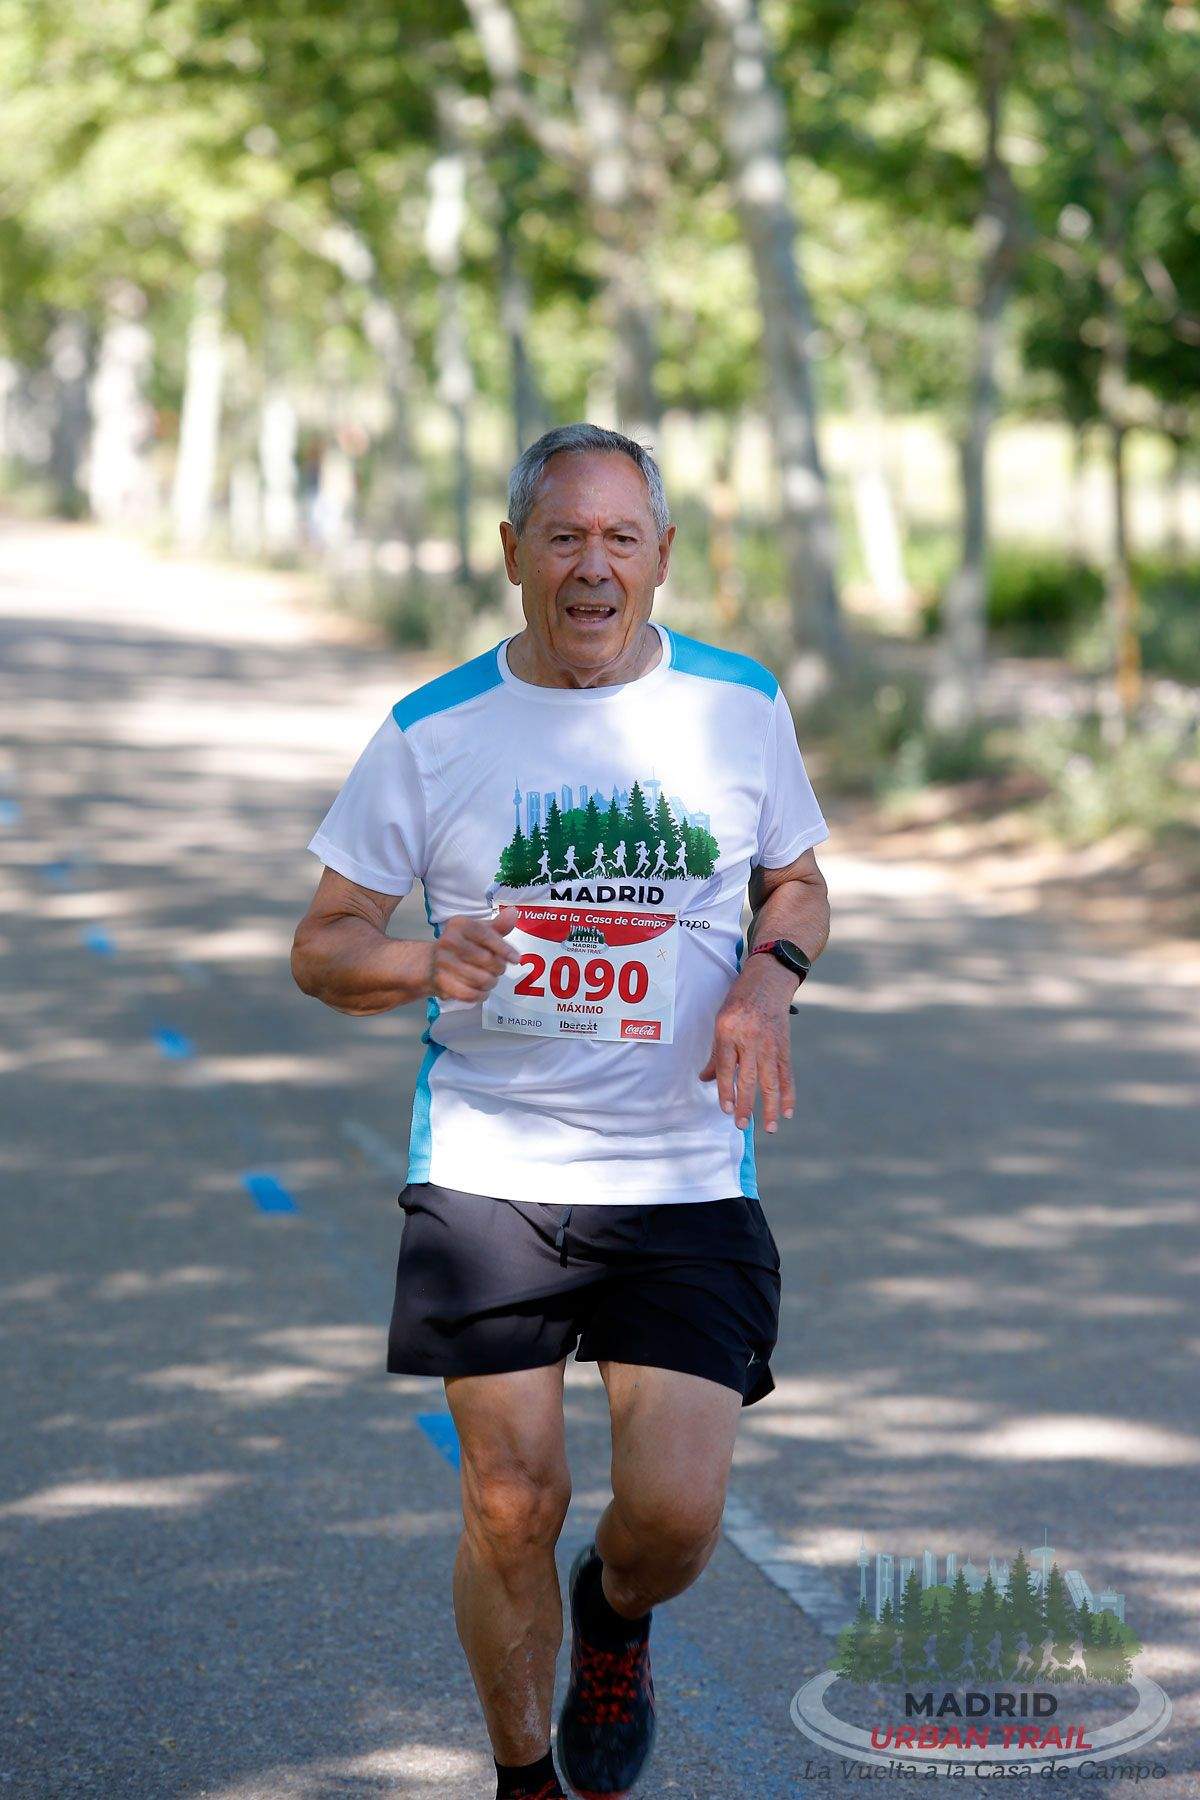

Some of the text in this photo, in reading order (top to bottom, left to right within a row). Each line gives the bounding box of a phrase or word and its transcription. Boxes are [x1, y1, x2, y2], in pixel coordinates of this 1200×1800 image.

[550, 886, 664, 905] MADRID
[524, 911, 557, 921] Vuelta
[569, 913, 580, 922] la
[585, 914, 612, 924] Casa
[614, 916, 628, 925] de
[630, 917, 667, 928] Campo
[514, 953, 648, 1004] 2090
[556, 1002, 604, 1014] MÁXIMO
[507, 1017, 542, 1027] MADRID
